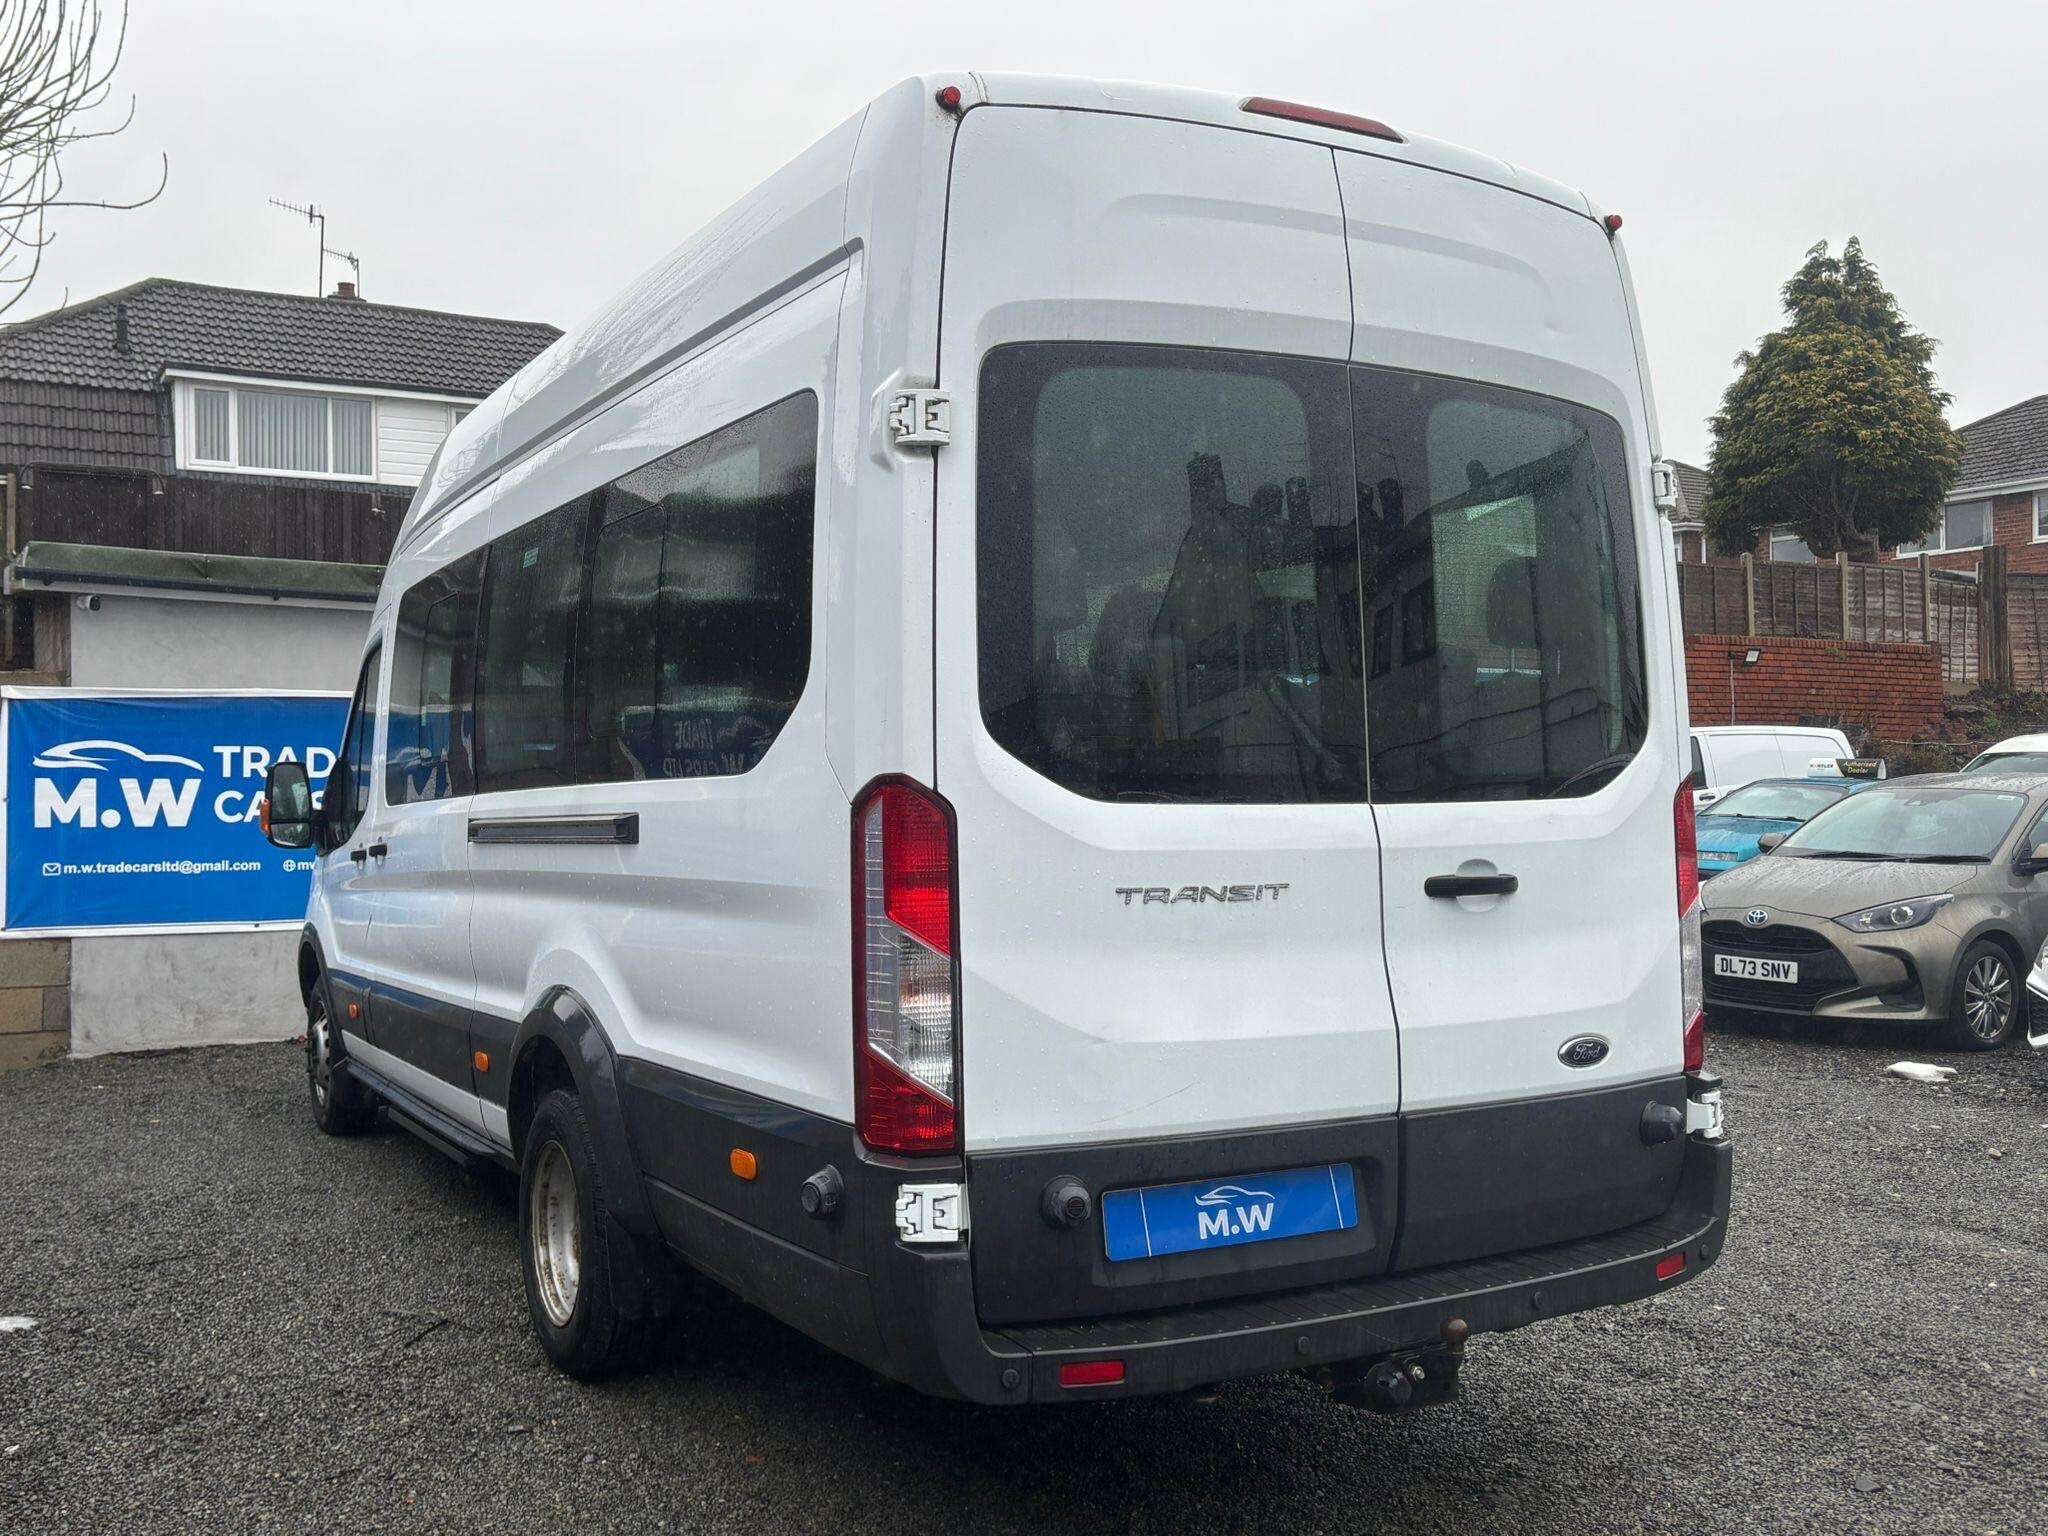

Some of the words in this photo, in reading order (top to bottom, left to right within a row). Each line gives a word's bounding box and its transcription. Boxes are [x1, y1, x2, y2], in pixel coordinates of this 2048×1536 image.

[213, 745, 336, 778] TRAD
[33, 777, 202, 828] M.W
[63, 860, 261, 875] m.w.tradecarsltd@gmail.com
[1115, 883, 1290, 905] TRANSIT
[1720, 957, 1757, 976] DL73
[1761, 961, 1791, 980] SNV
[1573, 1042, 1601, 1060] Ford
[1198, 1202, 1274, 1240] M.W
